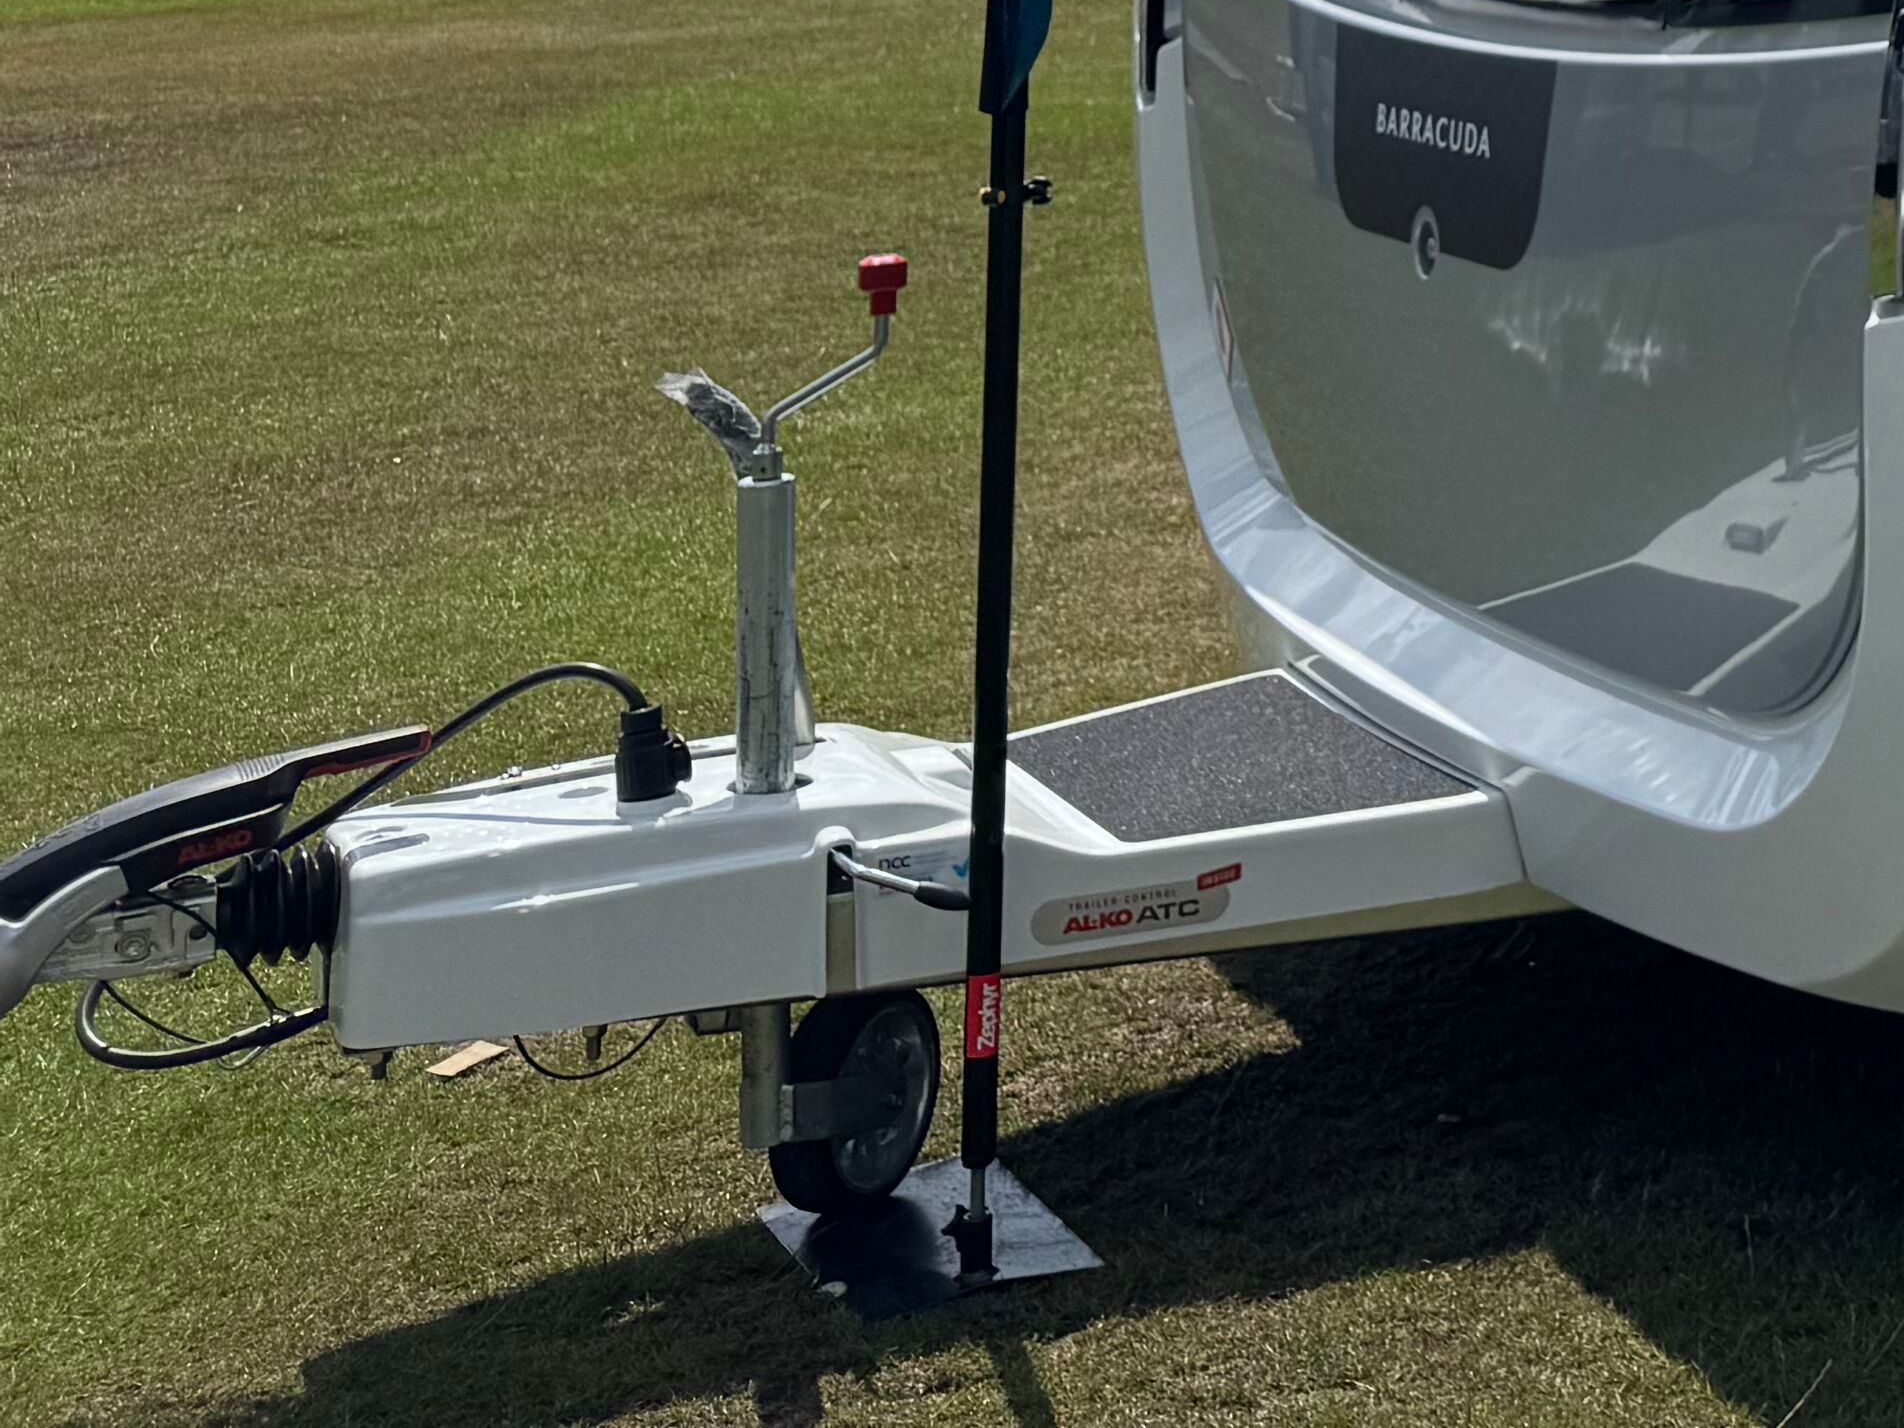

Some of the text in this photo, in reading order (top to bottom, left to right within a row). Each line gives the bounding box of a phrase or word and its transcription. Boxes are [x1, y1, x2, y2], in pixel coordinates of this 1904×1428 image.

[1375, 102, 1491, 159] BARRACUDA
[1137, 899, 1200, 923] ATC
[977, 983, 999, 1051] Zephyr
